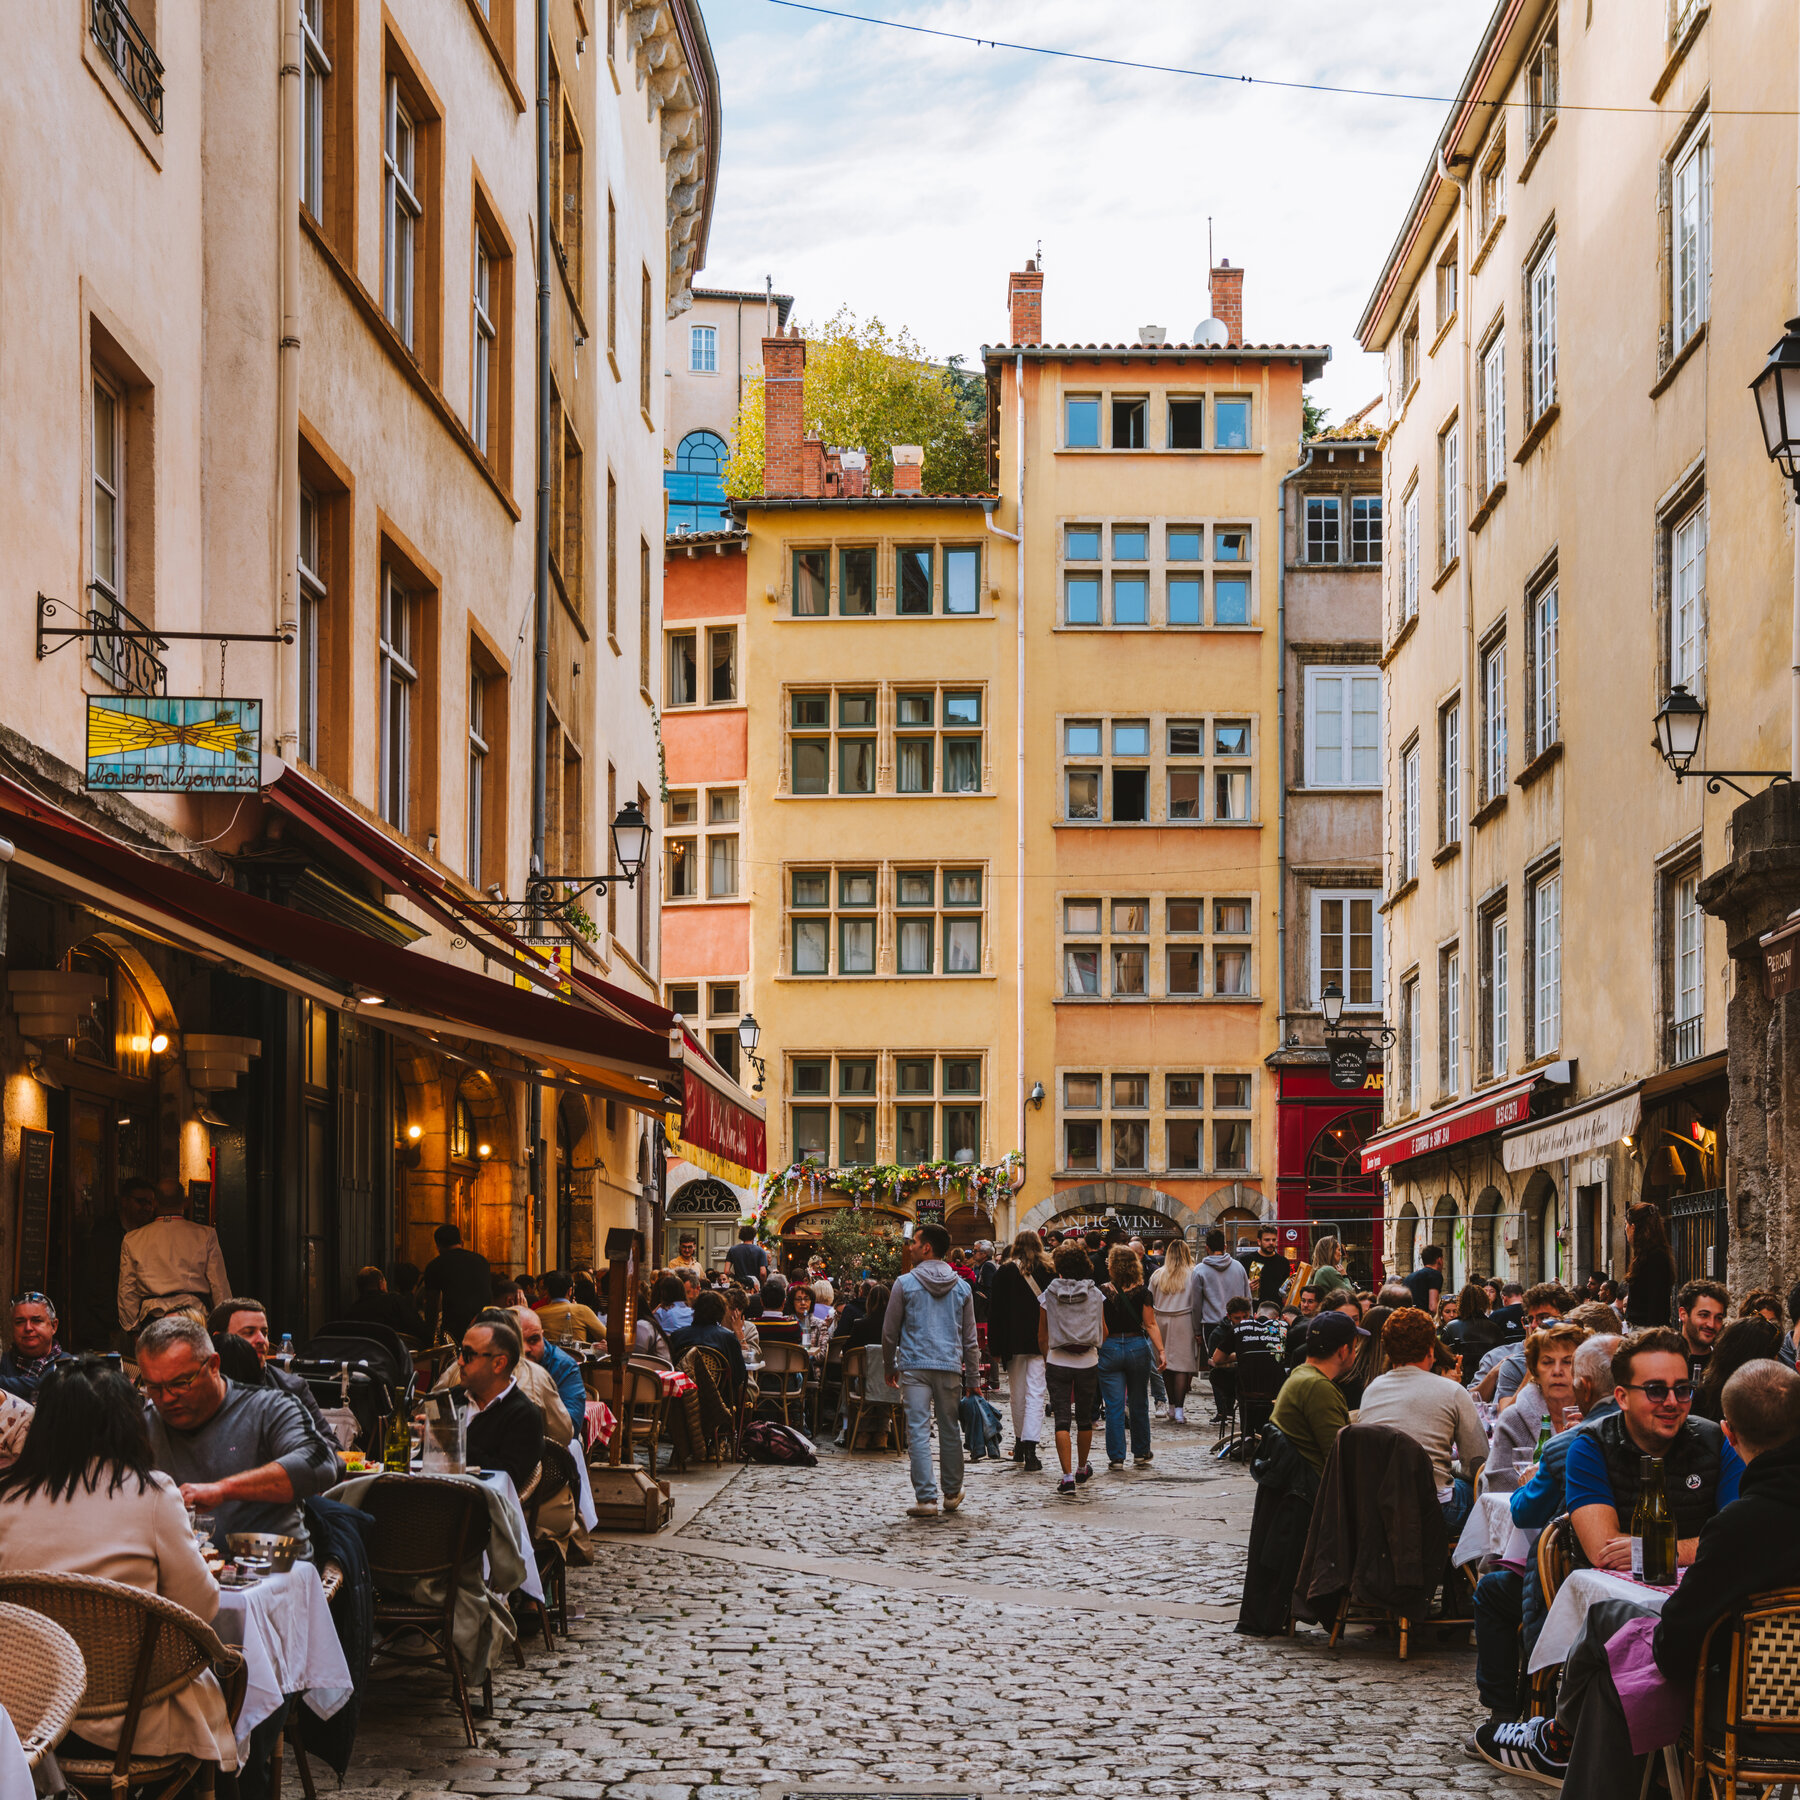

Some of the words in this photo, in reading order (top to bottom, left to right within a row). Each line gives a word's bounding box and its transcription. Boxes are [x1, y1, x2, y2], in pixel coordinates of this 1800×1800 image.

[88, 763, 167, 787] bouchon
[170, 766, 258, 791] lyonnais
[1767, 949, 1792, 972] PERONI
[1055, 1214, 1110, 1229] ANTIC
[1115, 1214, 1163, 1229] WINE
